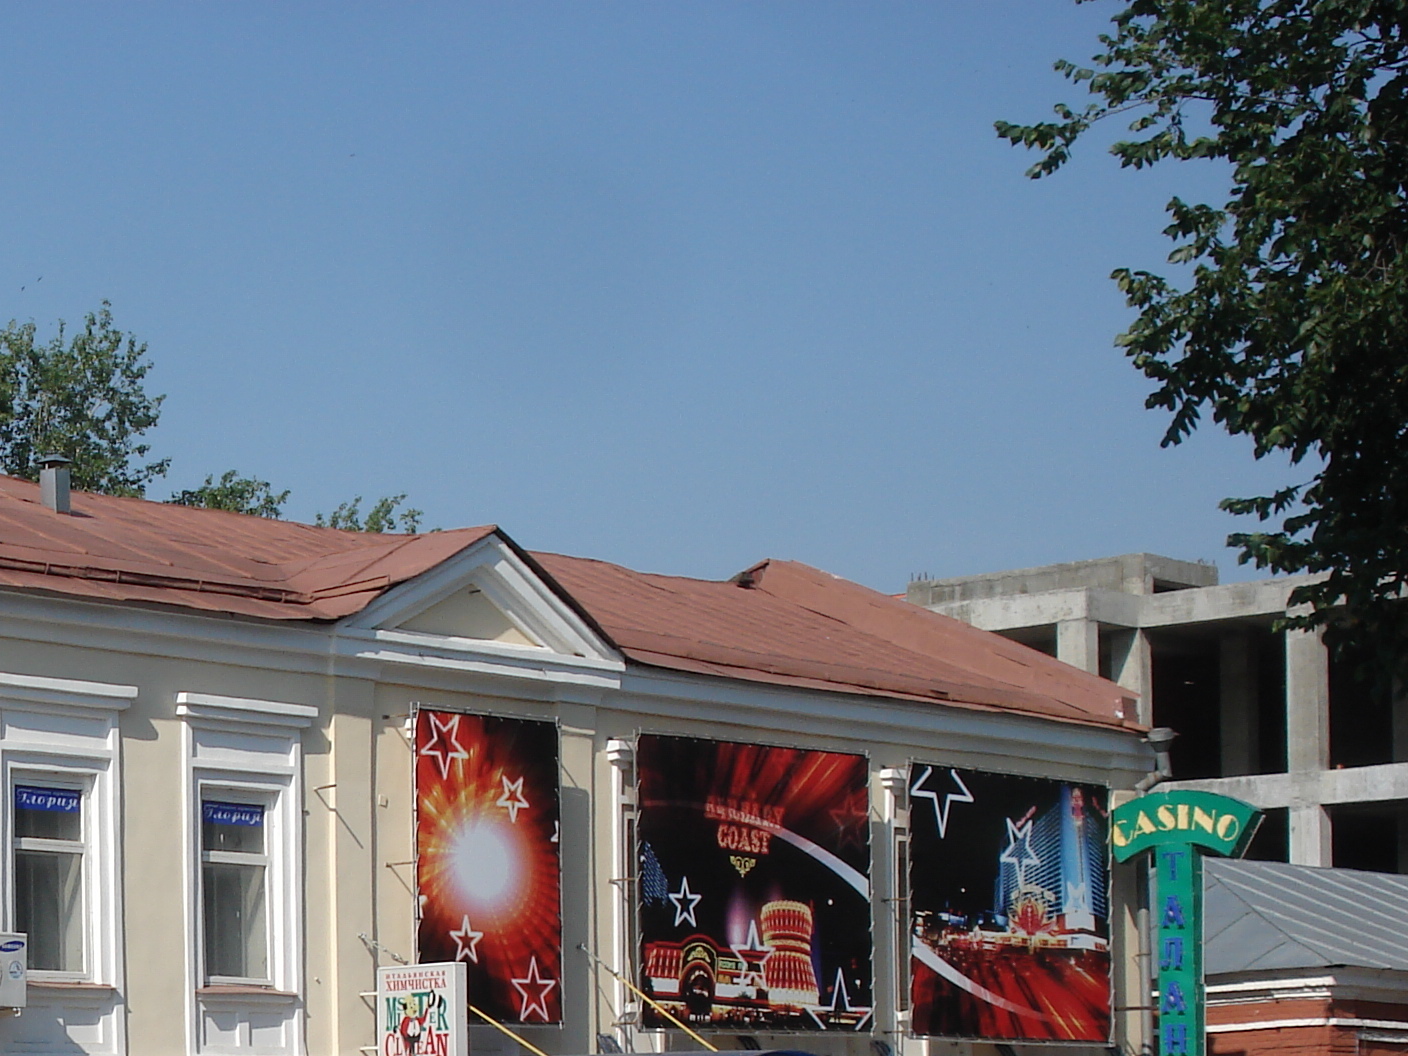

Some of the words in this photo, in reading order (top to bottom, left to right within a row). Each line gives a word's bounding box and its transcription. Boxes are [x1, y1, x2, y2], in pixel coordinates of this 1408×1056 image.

[17, 788, 78, 810] Глория
[203, 804, 262, 824] Глория
[1112, 804, 1240, 848] CASINO
[717, 823, 771, 854] COAST
[385, 970, 447, 980] ИТАЛЬЯНСКАЯ
[385, 978, 447, 992] ХИМЧИСТКА
